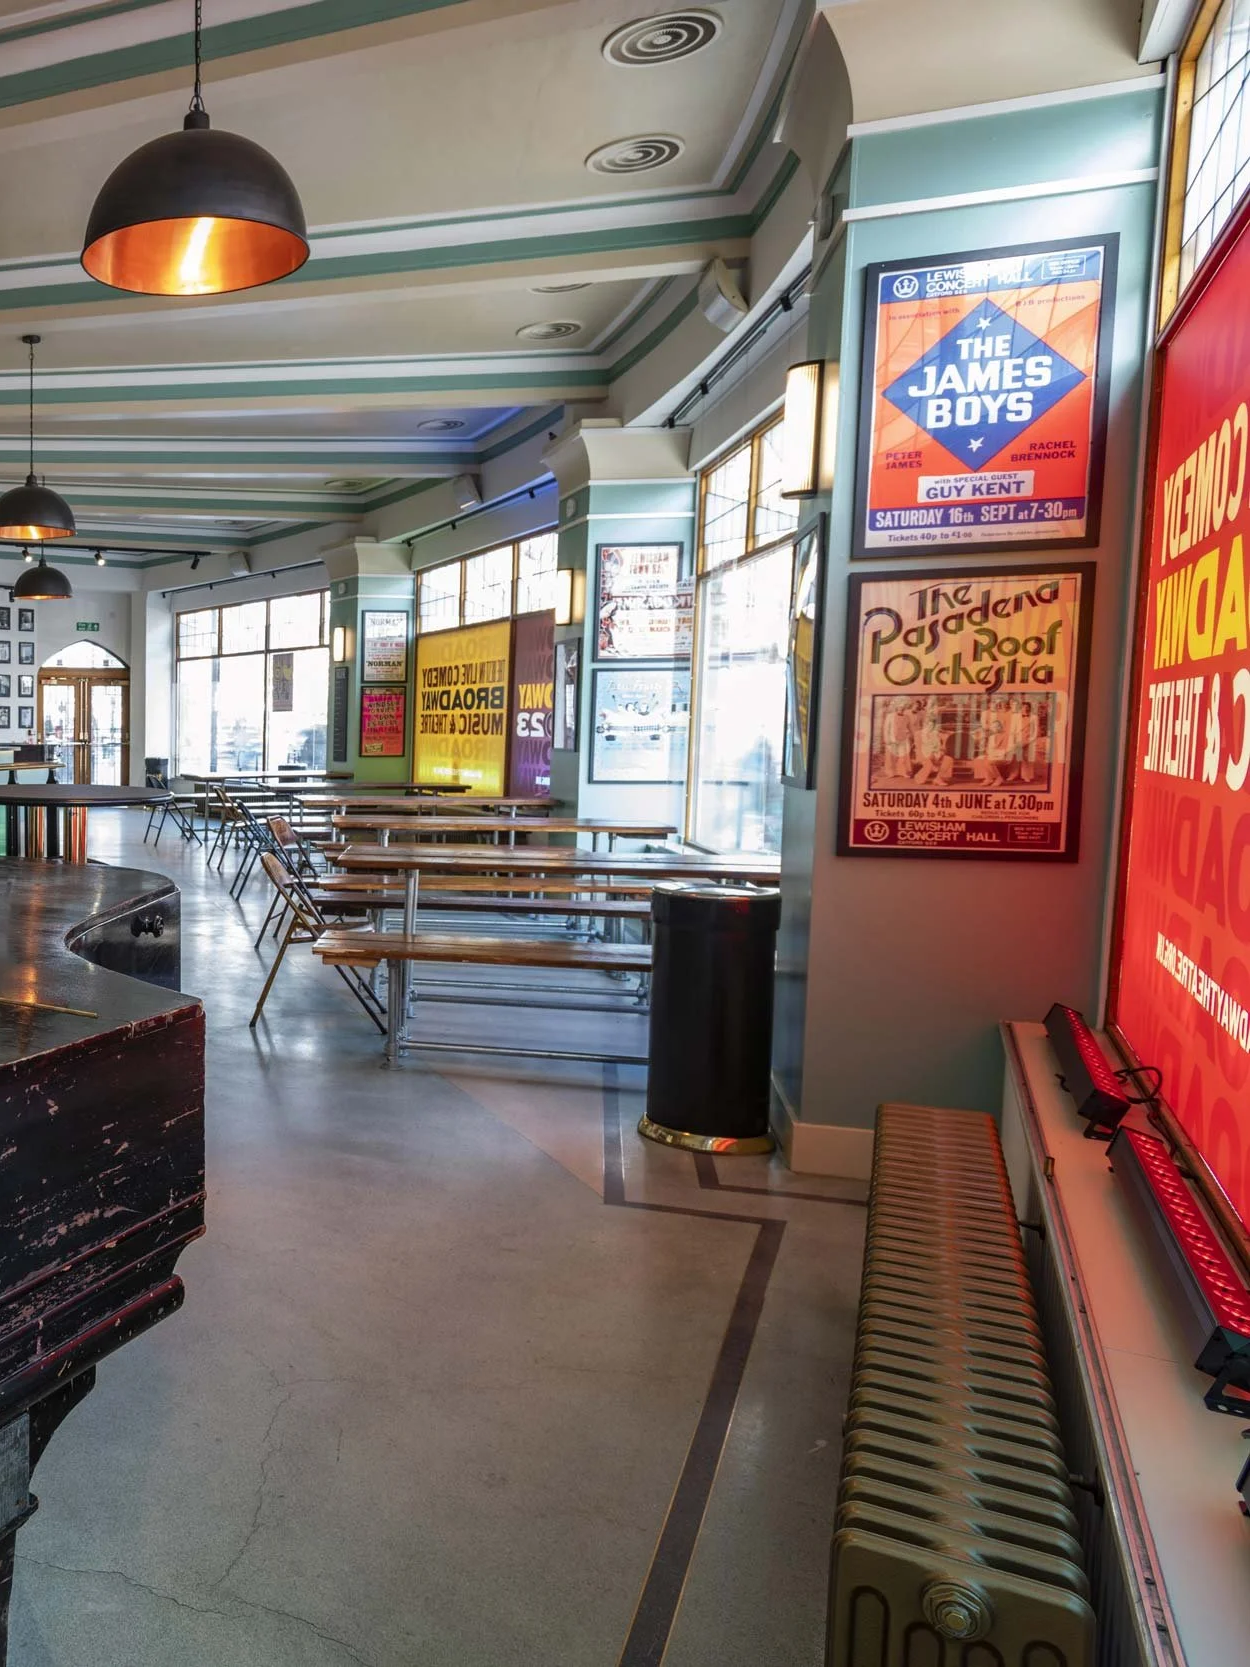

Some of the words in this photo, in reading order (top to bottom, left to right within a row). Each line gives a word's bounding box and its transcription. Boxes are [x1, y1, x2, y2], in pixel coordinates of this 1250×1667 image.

[956, 334, 1011, 360] THE
[908, 355, 1053, 398] JAMES
[926, 391, 1033, 429] BOYS
[1029, 440, 1077, 451] RACHEL
[885, 451, 922, 461] PETER
[1010, 450, 1076, 462] BRENNOCK
[885, 460, 923, 470] JAMES
[953, 475, 989, 484] SPECIAL
[990, 472, 1018, 482] GUEST
[925, 486, 966, 500] GUY
[971, 480, 1025, 497] KENT
[875, 508, 944, 528] SATURDAY
[948, 507, 974, 524] 16th
[980, 504, 1017, 521] SEPT
[1018, 509, 1028, 520] at
[887, 532, 918, 542] Tickets
[919, 532, 938, 542] 40p
[940, 532, 949, 540] to
[909, 583, 972, 621] The
[864, 580, 1060, 665] Pasadena
[973, 620, 1063, 663] Roof
[883, 652, 1054, 695] Orchestra
[863, 793, 930, 808] SATURDAY
[932, 794, 952, 809] 4th
[955, 794, 992, 810] JUNE
[994, 797, 1006, 810] at
[875, 809, 905, 818] Tickets
[908, 809, 924, 819] 60p
[926, 810, 935, 818] to
[898, 821, 966, 832] LEWISHAM
[897, 830, 959, 841] CONCERT
[966, 832, 1001, 843] HALL
